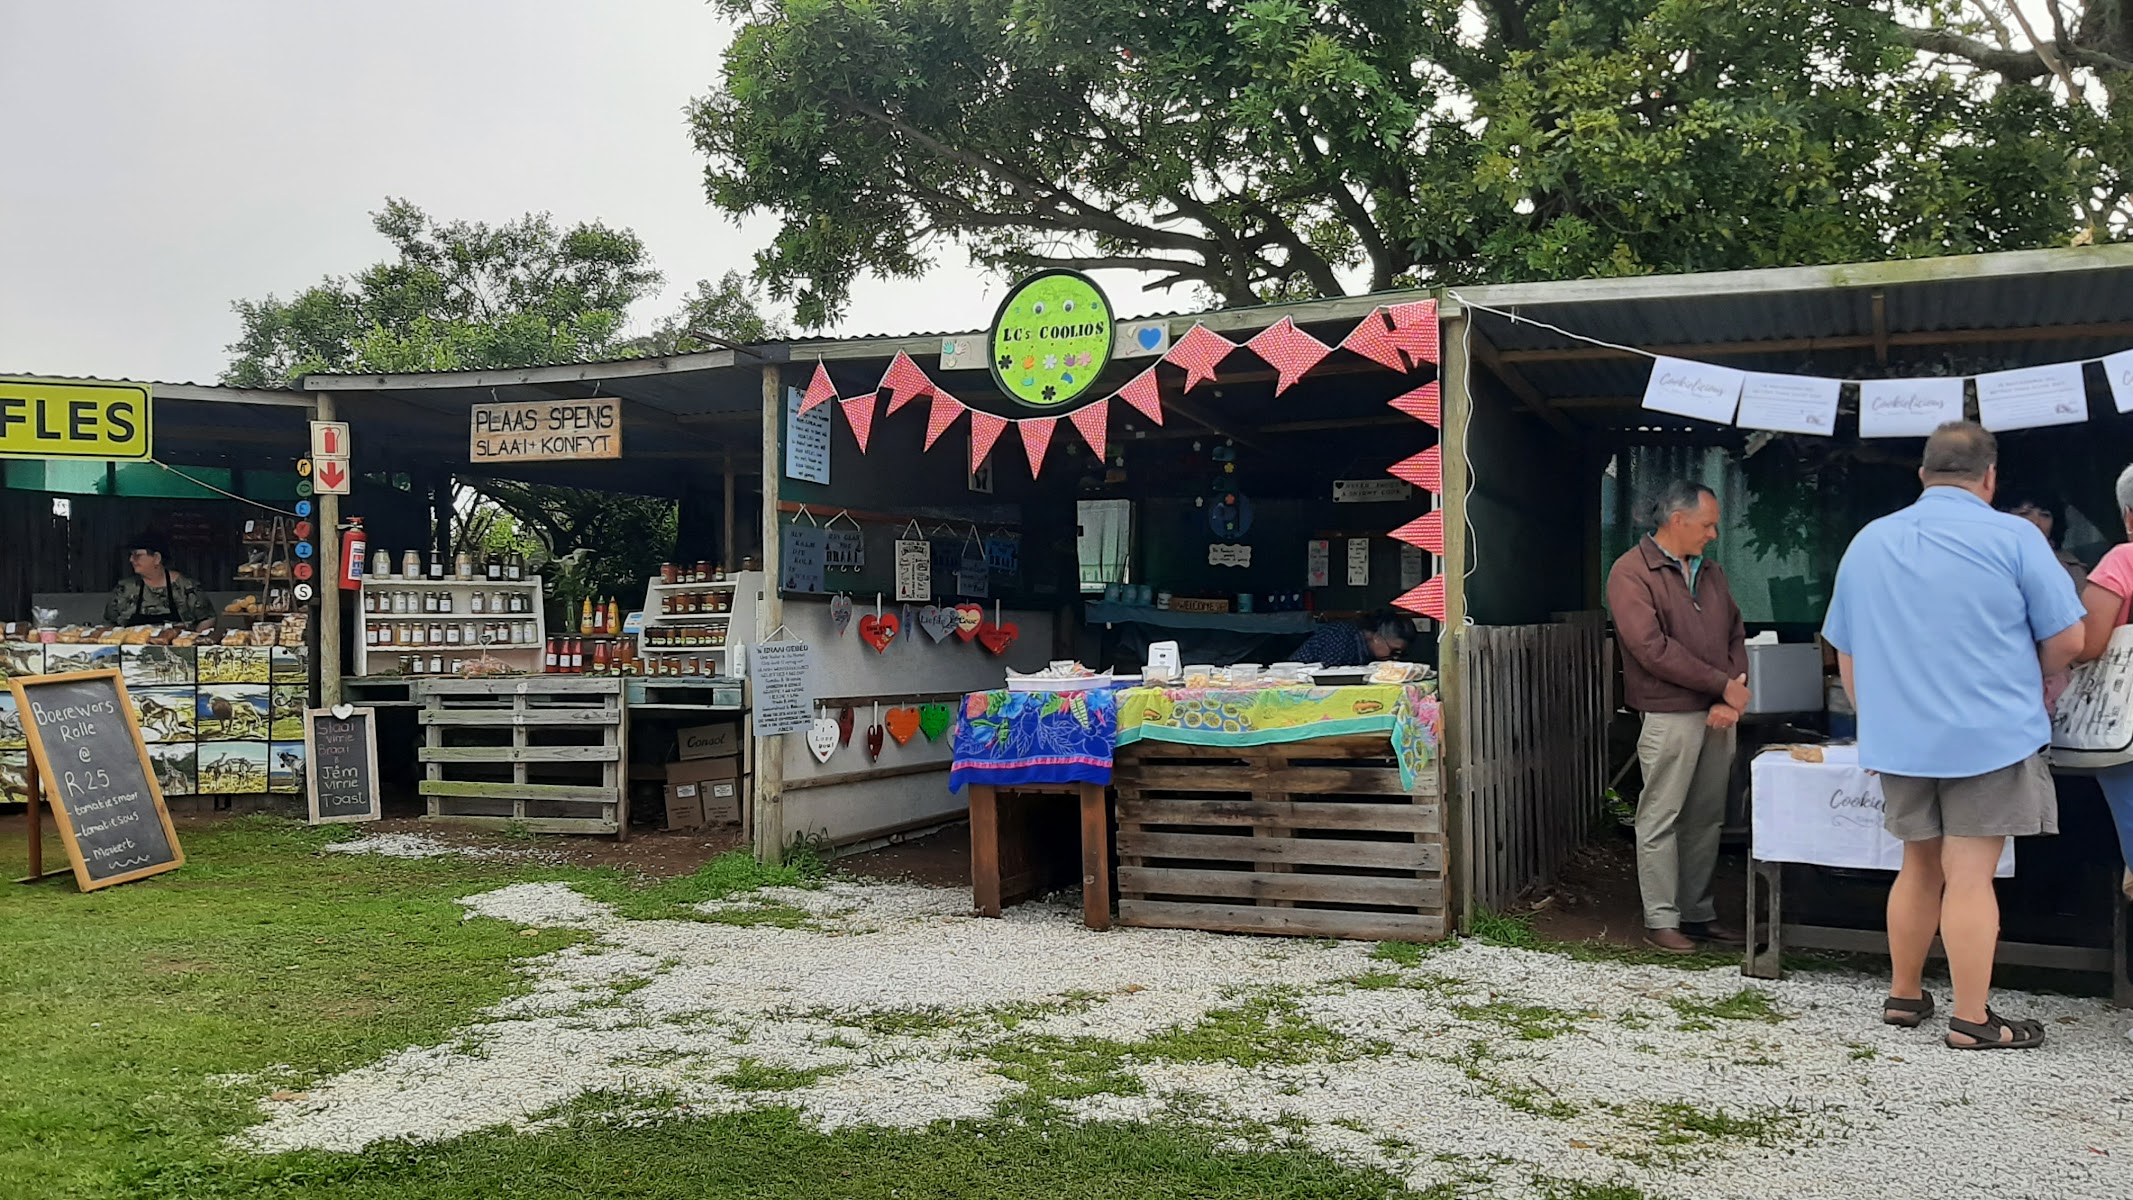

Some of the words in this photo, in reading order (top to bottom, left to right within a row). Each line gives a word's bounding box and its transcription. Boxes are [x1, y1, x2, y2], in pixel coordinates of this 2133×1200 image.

[1039, 321, 1104, 339] COOLIOS
[0, 398, 135, 443] FLES
[476, 409, 538, 433] PLAAS
[548, 404, 614, 430] SPENS
[540, 435, 612, 454] KONFYT
[60, 721, 97, 742] Rolle
[317, 721, 355, 736] Slaai
[687, 732, 726, 748] Consol
[78, 746, 91, 763] @
[318, 744, 350, 756] Braai
[324, 779, 359, 790] virrie
[320, 791, 367, 808] Toast
